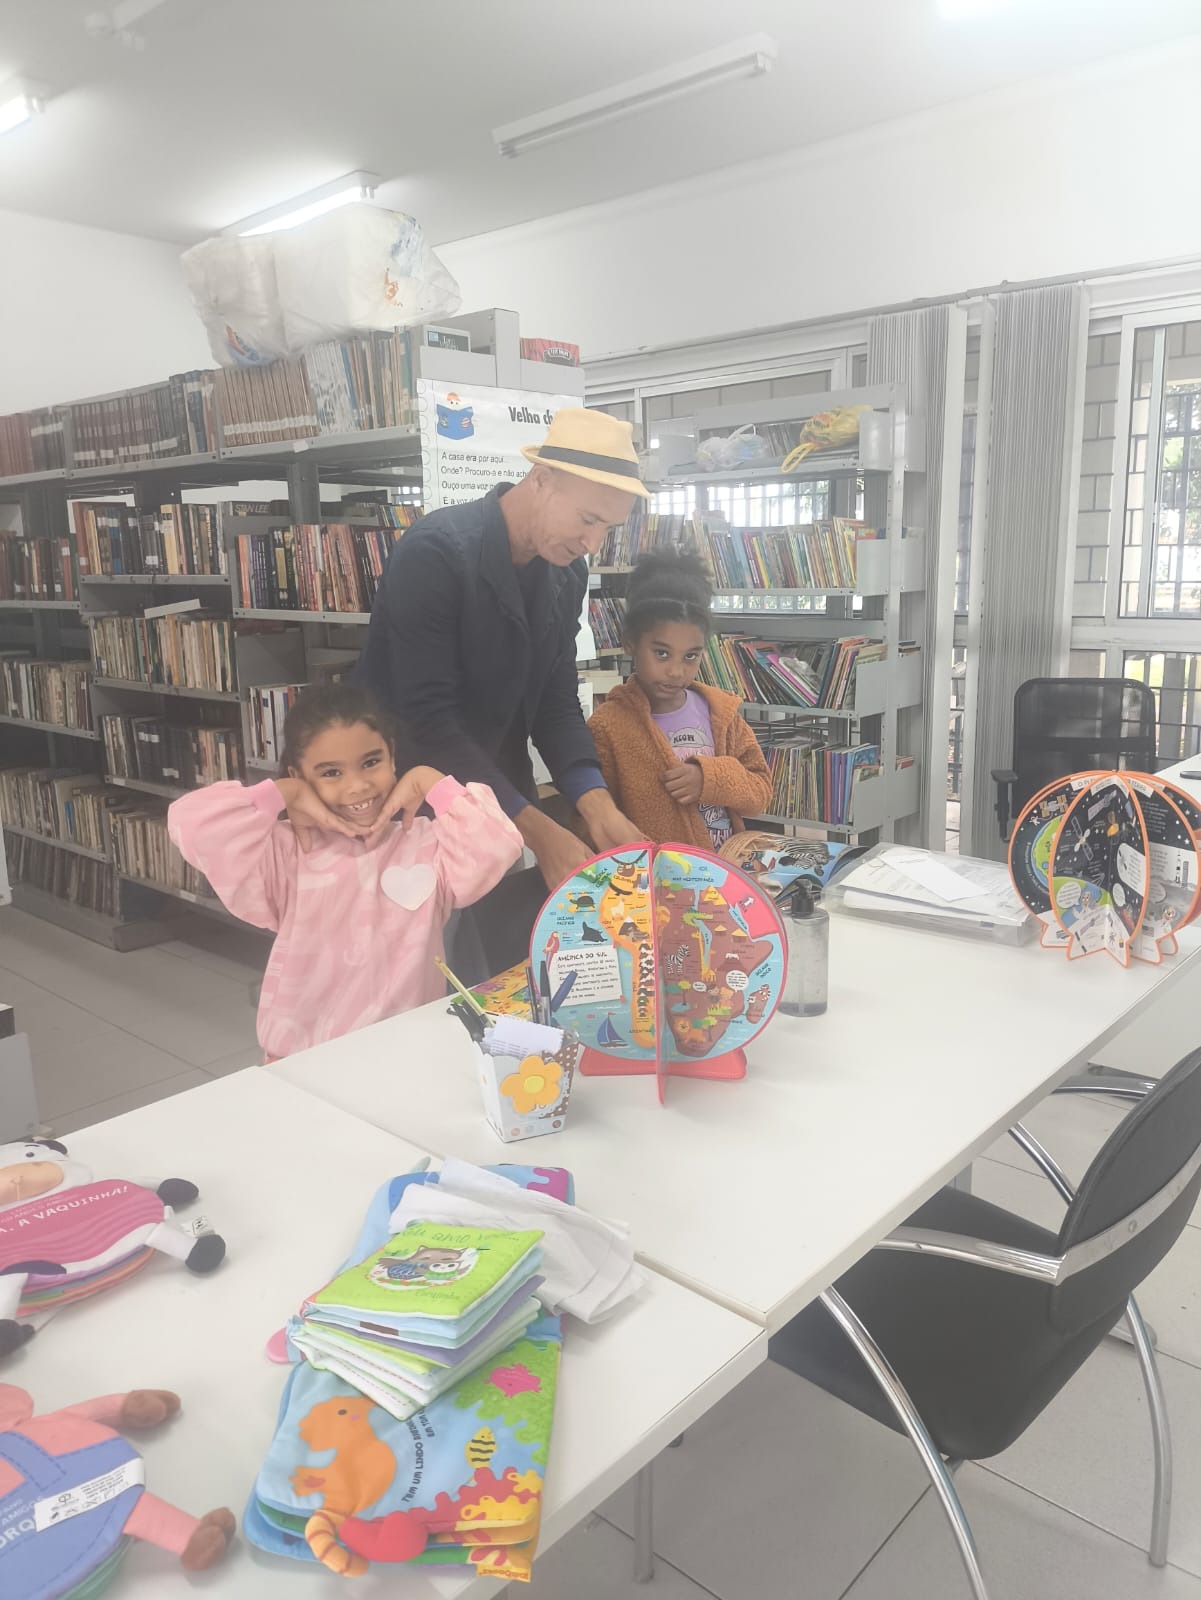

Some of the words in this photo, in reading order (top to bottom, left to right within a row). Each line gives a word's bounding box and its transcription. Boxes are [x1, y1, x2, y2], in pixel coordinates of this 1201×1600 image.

[508, 406, 541, 424] Velha
[441, 451, 447, 460] A
[478, 455, 489, 463] por
[440, 465, 464, 475] Onde?
[465, 467, 497, 477] Procuro-a
[503, 469, 514, 477] não
[441, 480, 460, 491] Ouço
[255, 503, 270, 513] LEE
[557, 953, 584, 962] AMÉRICA
[18, 1218, 31, 1227] A
[32, 1185, 129, 1220] VAQUINHA!
[414, 1441, 424, 1469] LINDO
[412, 1471, 423, 1485] UM
[401, 1486, 419, 1503] TEM
